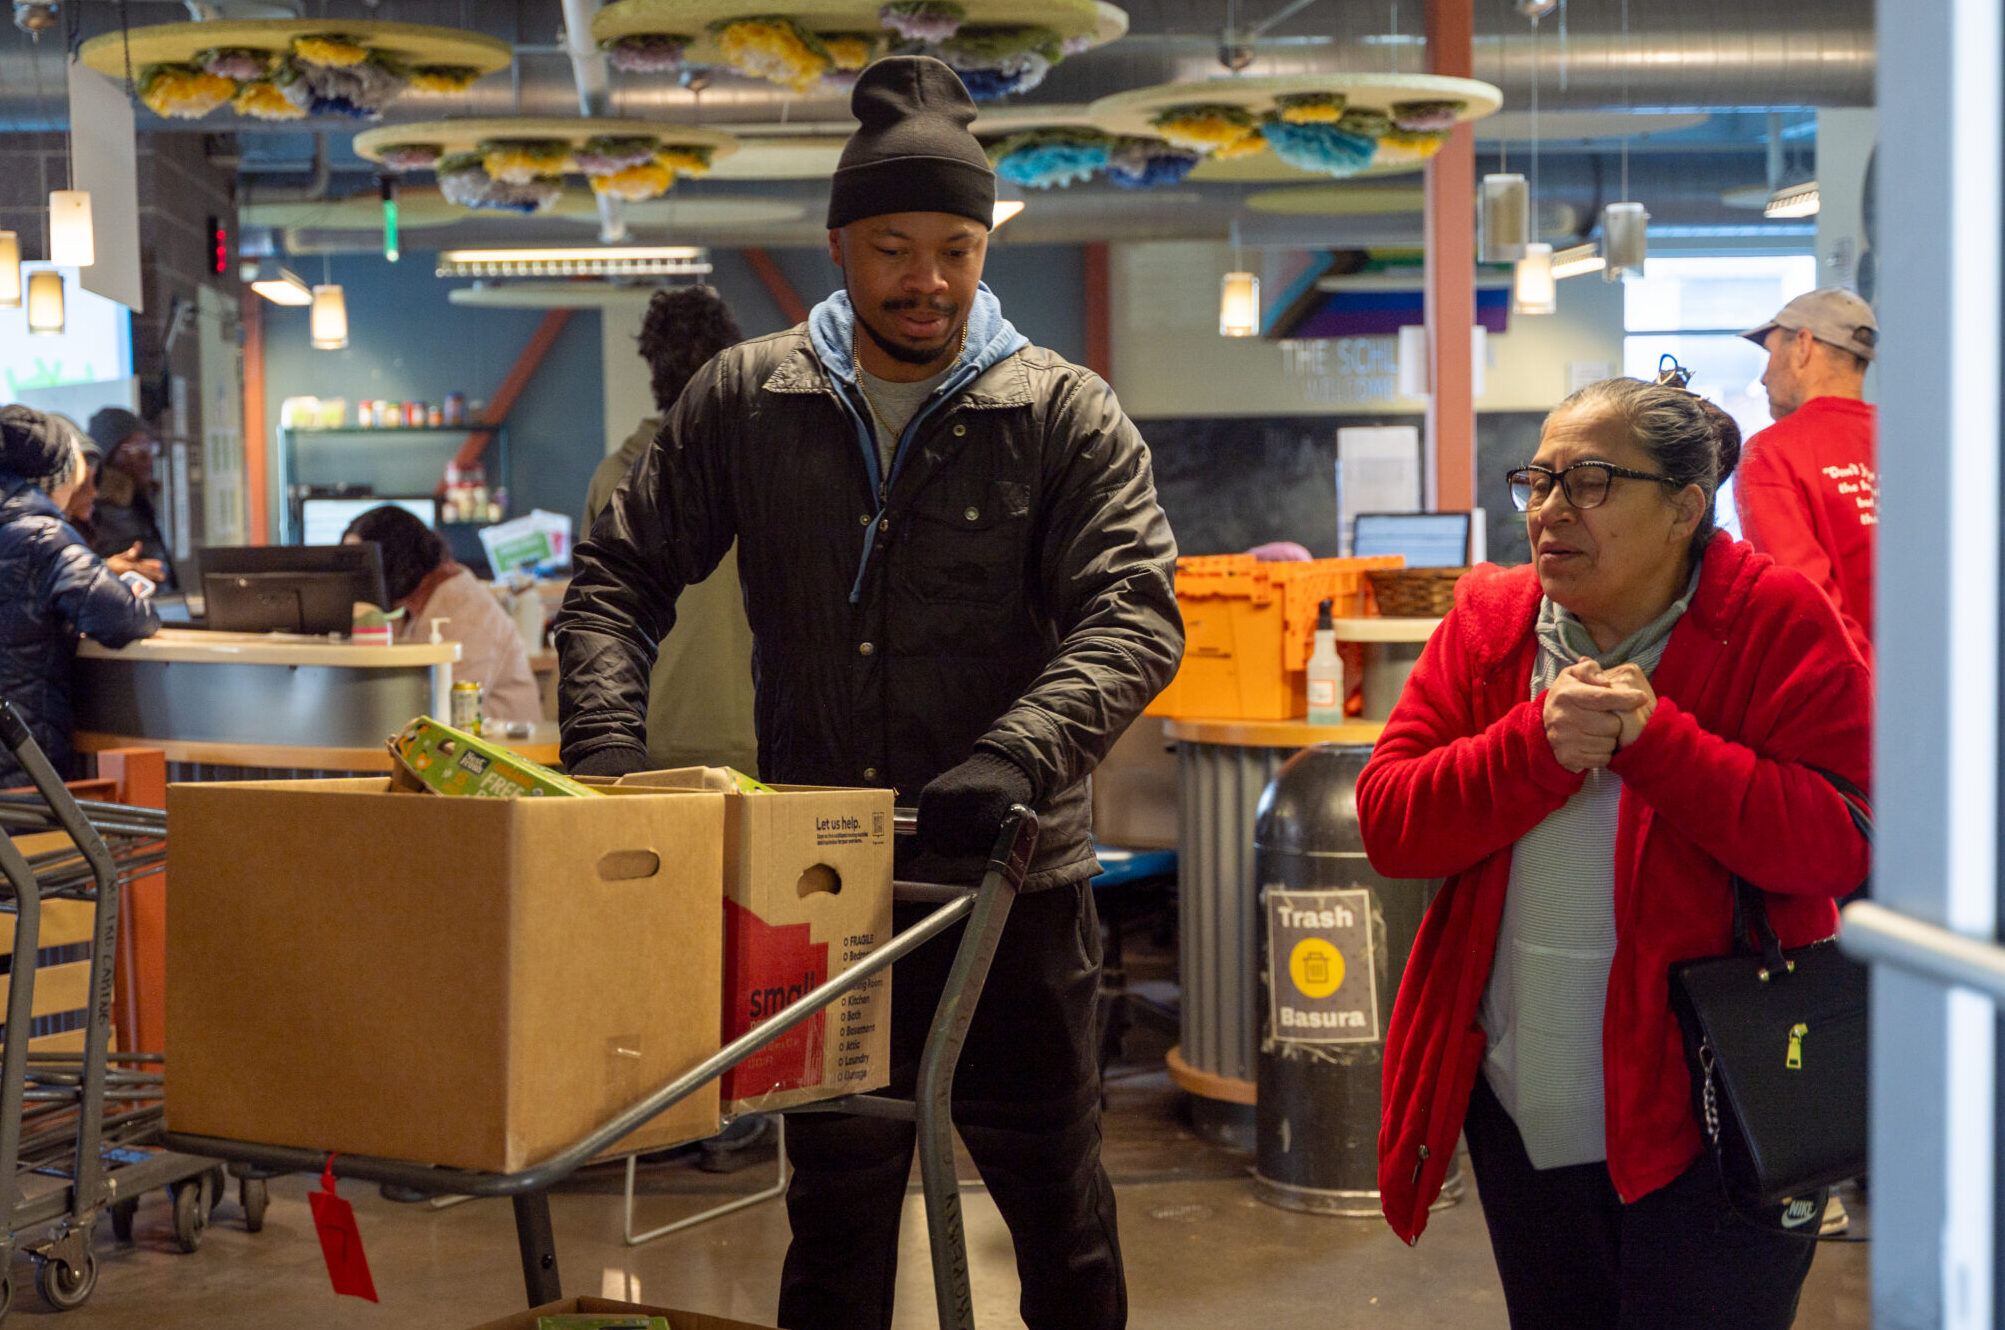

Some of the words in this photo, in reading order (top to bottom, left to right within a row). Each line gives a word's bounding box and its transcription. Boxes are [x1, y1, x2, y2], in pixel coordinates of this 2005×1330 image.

[1277, 339, 1330, 375] THE
[1336, 337, 1399, 375] SCHL
[480, 772, 526, 797] FREE
[816, 817, 830, 831] Let
[831, 819, 841, 831] us
[841, 816, 861, 831] help.
[1278, 904, 1354, 929] Trash
[850, 934, 875, 946] FRAGILE
[749, 970, 816, 1018] small
[848, 995, 871, 1006] Kitchen
[847, 1010, 861, 1021] Bath
[1280, 1006, 1367, 1028] Basura
[846, 1024, 876, 1036] Basement
[846, 1041, 861, 1051] Attic
[845, 1053, 870, 1067] Laundry
[1789, 1199, 1814, 1217] NIKE
